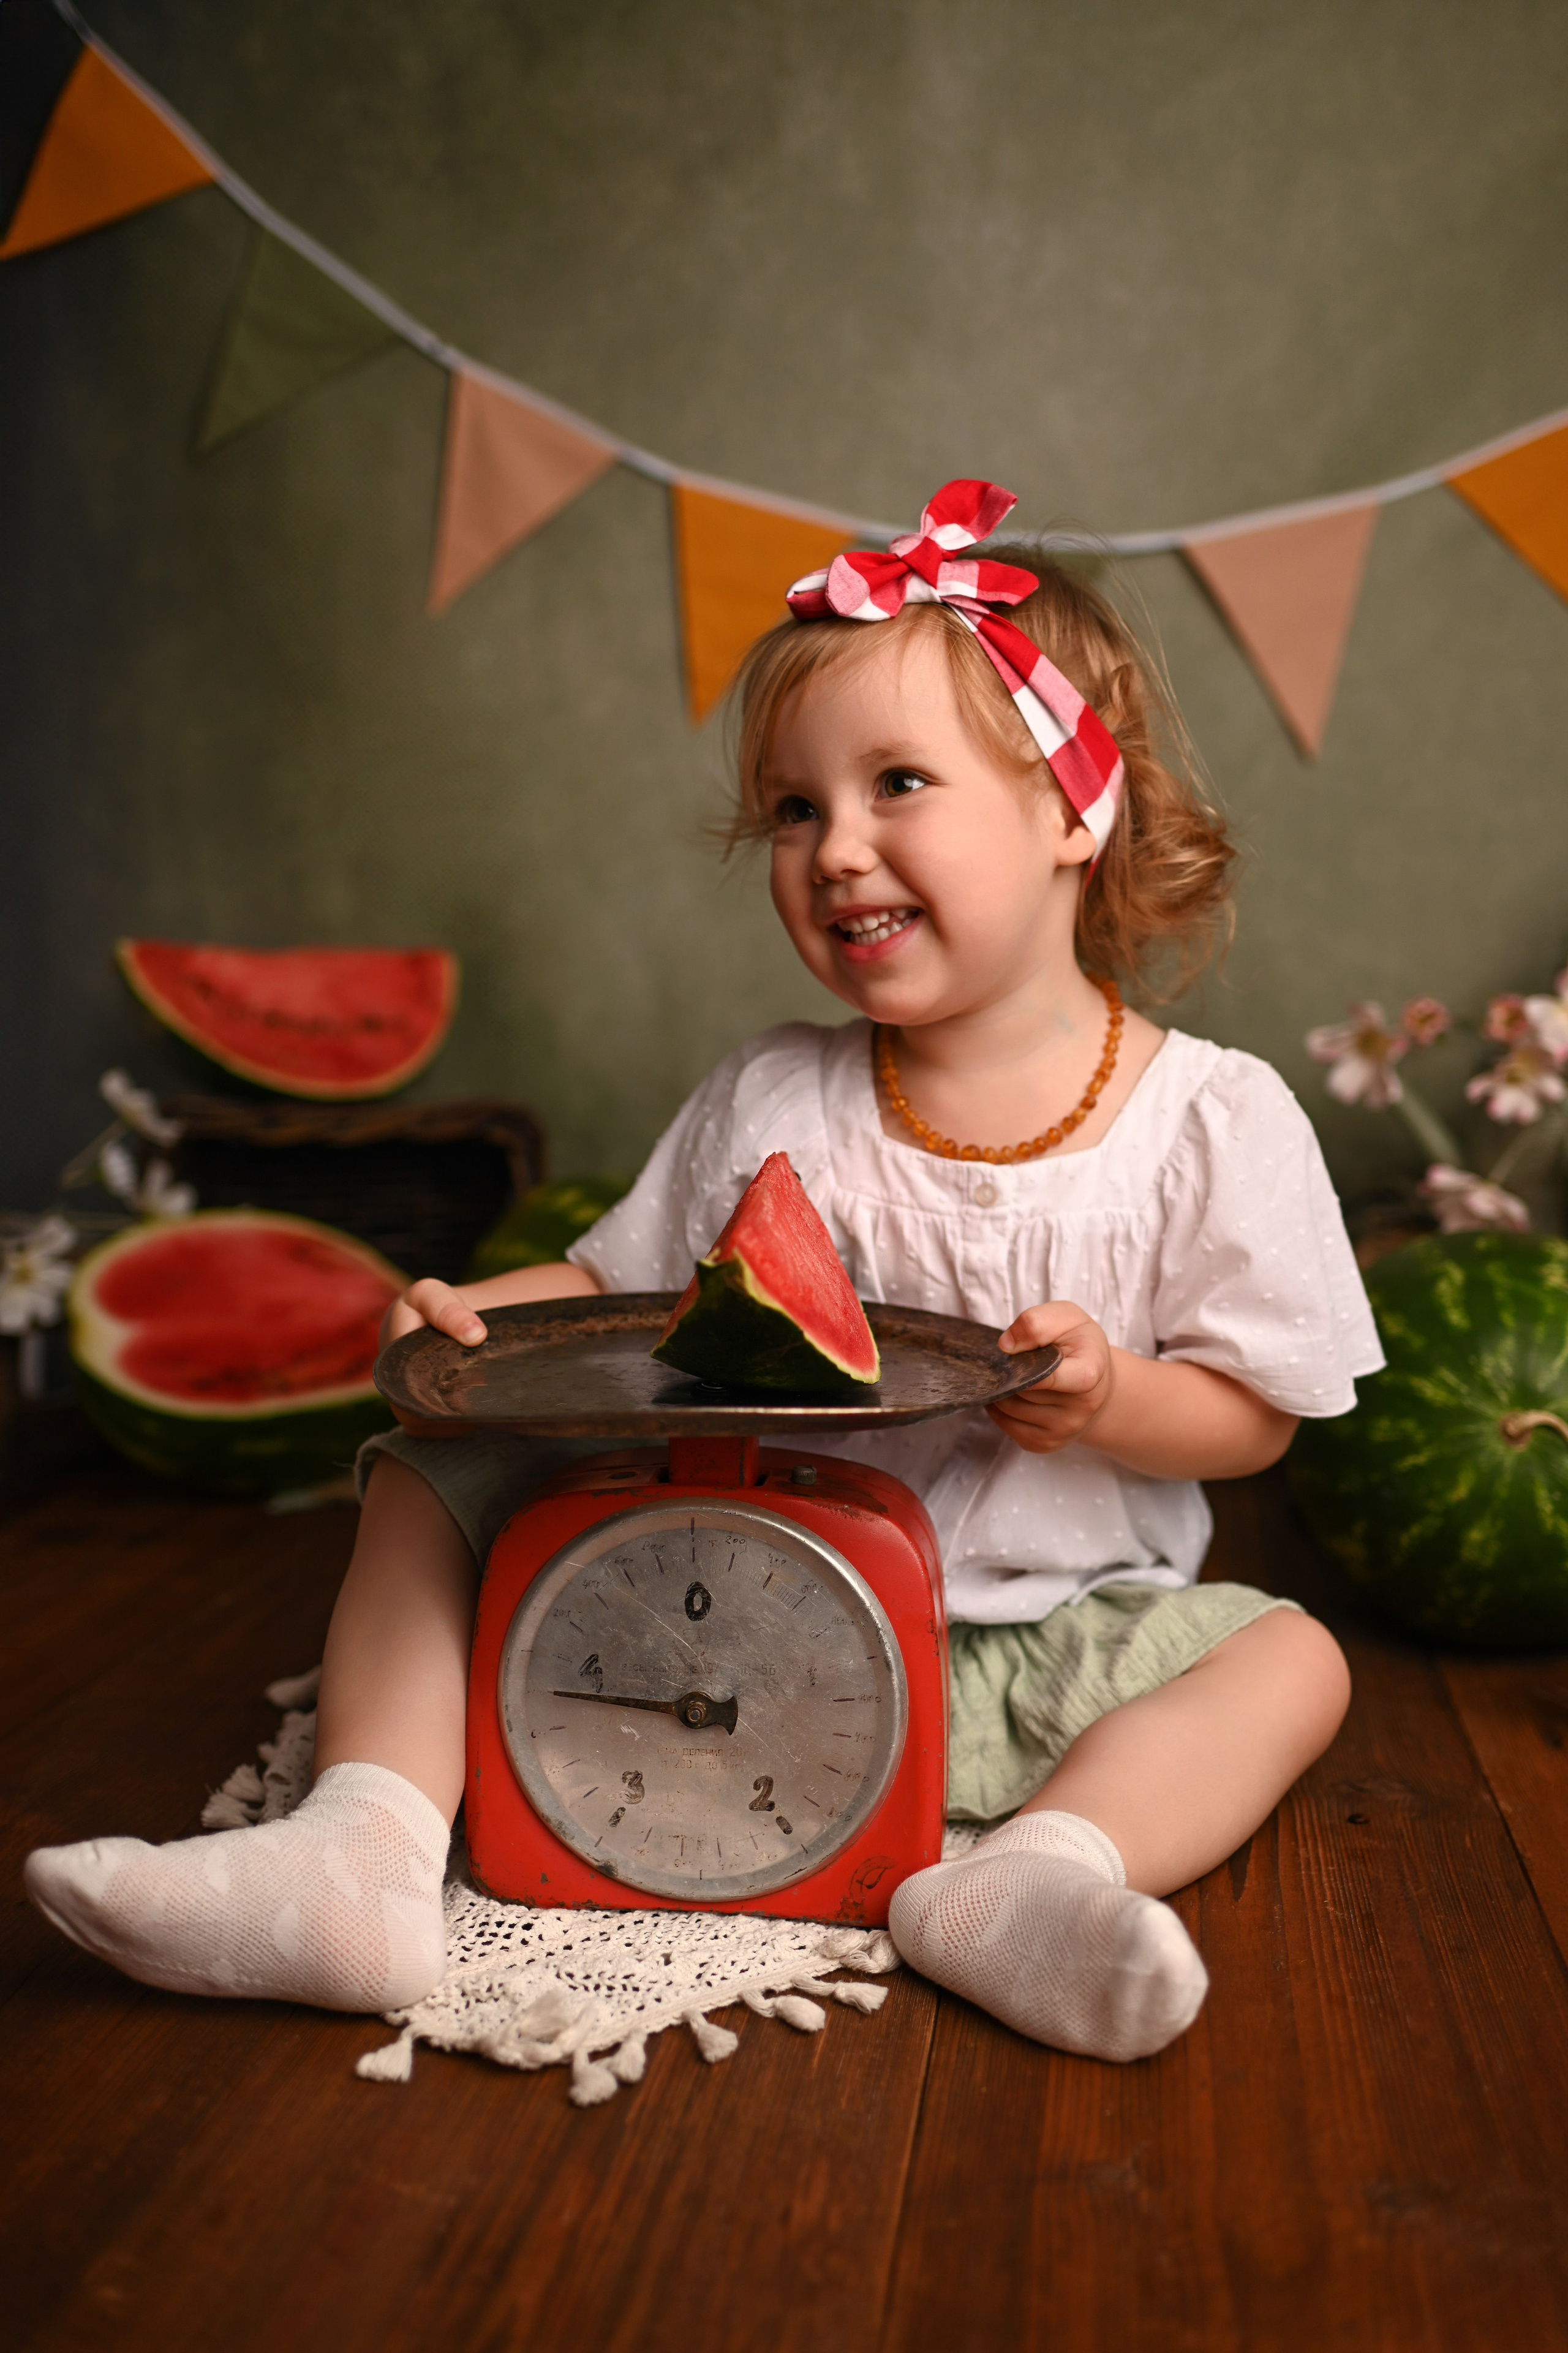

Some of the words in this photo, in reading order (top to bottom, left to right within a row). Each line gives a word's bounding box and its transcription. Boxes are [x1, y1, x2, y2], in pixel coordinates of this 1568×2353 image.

[685, 1582, 711, 1622] 0
[682, 1748, 723, 1756] ДЕЛЕНИЯ
[622, 1770, 645, 1804] 3
[748, 1775, 775, 1811] 2
